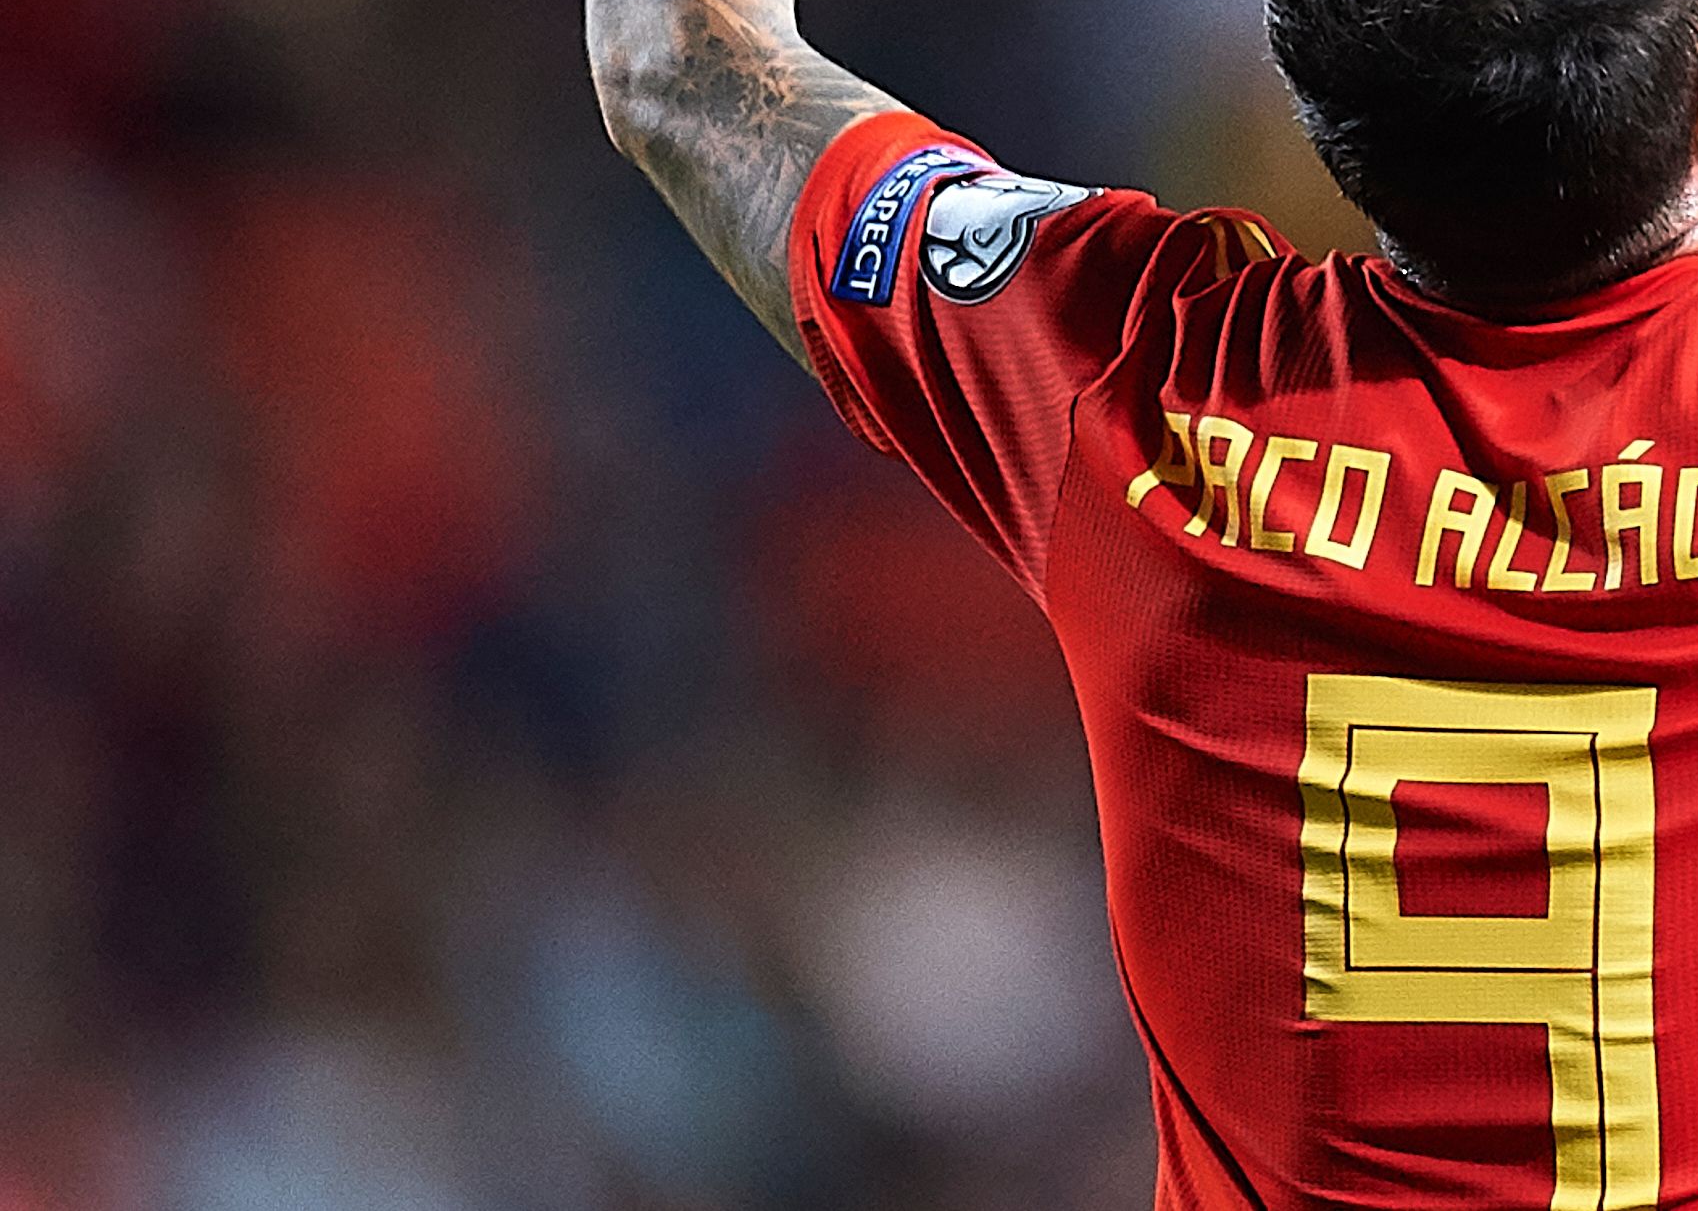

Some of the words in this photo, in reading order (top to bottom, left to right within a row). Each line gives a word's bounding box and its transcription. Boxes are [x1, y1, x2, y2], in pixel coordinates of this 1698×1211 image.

[849, 152, 951, 300] RESPECT
[1126, 411, 1392, 570] PACO
[1298, 673, 1660, 1211] 9
